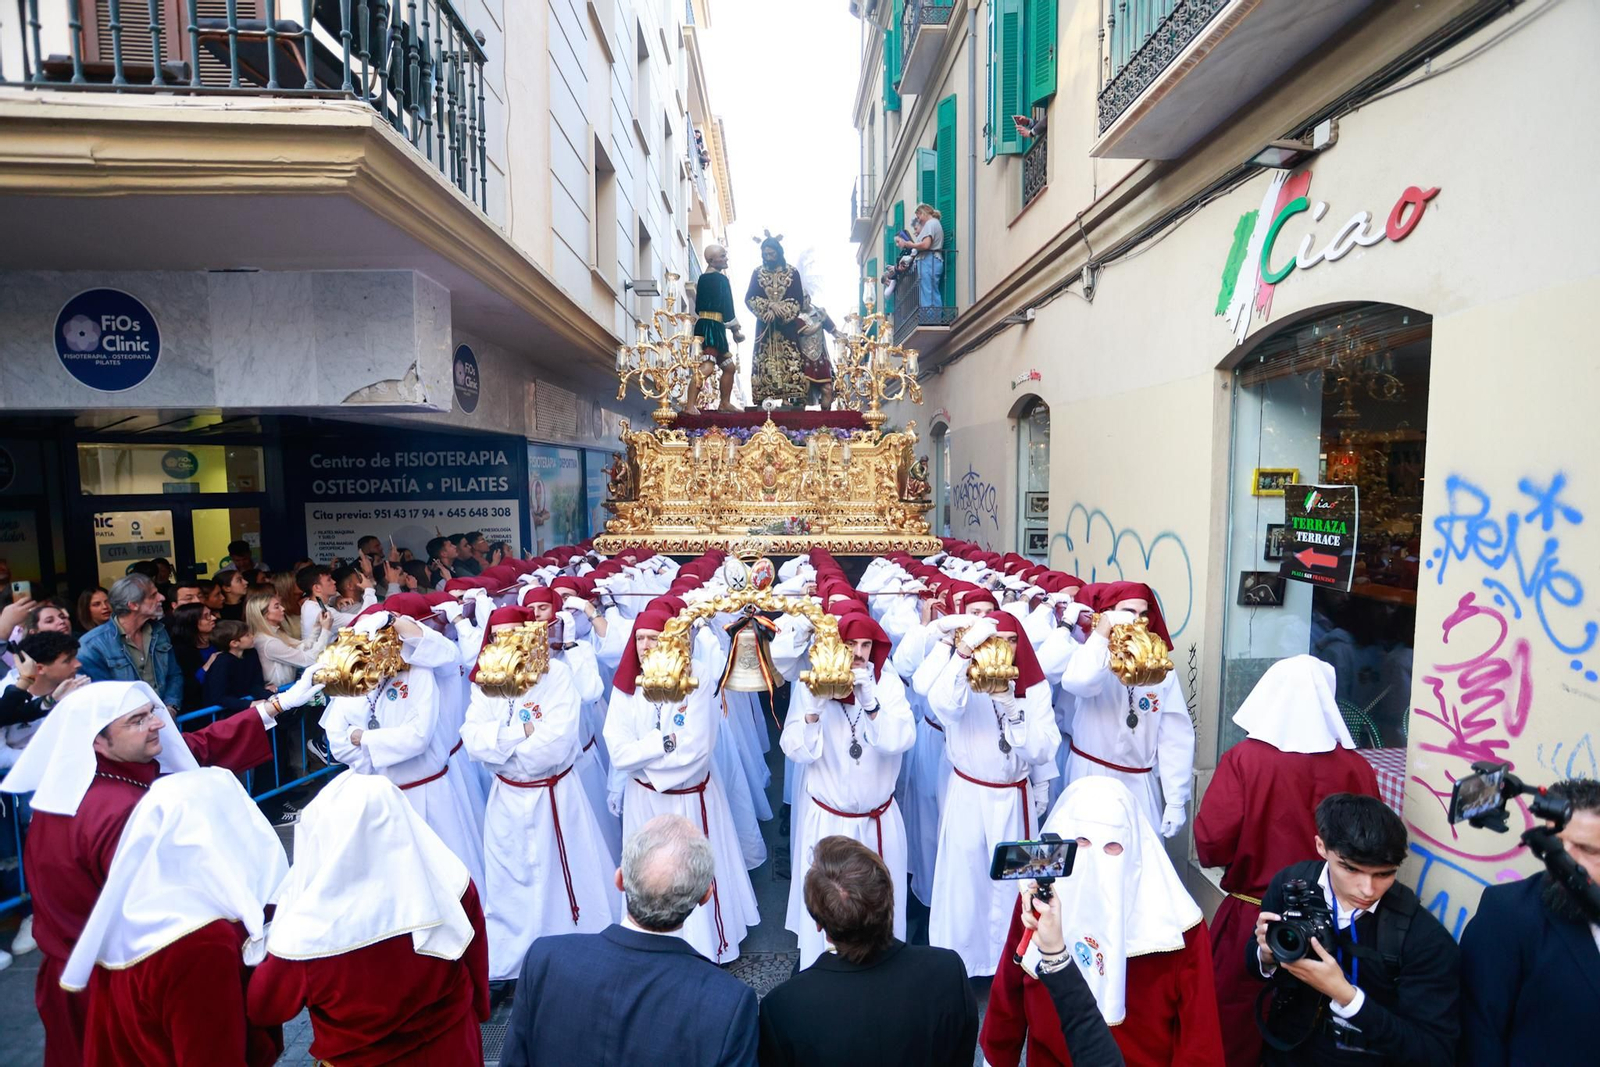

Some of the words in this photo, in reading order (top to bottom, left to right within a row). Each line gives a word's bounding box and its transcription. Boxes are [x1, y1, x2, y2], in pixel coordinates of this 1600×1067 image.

[1261, 186, 1442, 284] Ciao
[101, 315, 141, 332] FiOs
[102, 335, 150, 352] Clinic
[310, 453, 366, 469] Centro
[370, 450, 391, 468] de
[395, 450, 508, 467] FISIOTERAPIA
[312, 474, 420, 495] OSTEOPATÍA
[441, 476, 509, 493] PILATES
[312, 509, 334, 520] Cita
[336, 509, 372, 523] previa:
[374, 509, 392, 520] 951
[393, 509, 407, 519] 43
[409, 508, 420, 519] 17
[422, 508, 435, 519] 94
[447, 508, 467, 518] 645
[469, 508, 488, 518] 648
[491, 507, 511, 518] 308
[1292, 517, 1347, 534] TERRAZA
[1296, 531, 1340, 547] TERRACE
[107, 546, 128, 557] CITA
[137, 544, 164, 555] PREVIA
